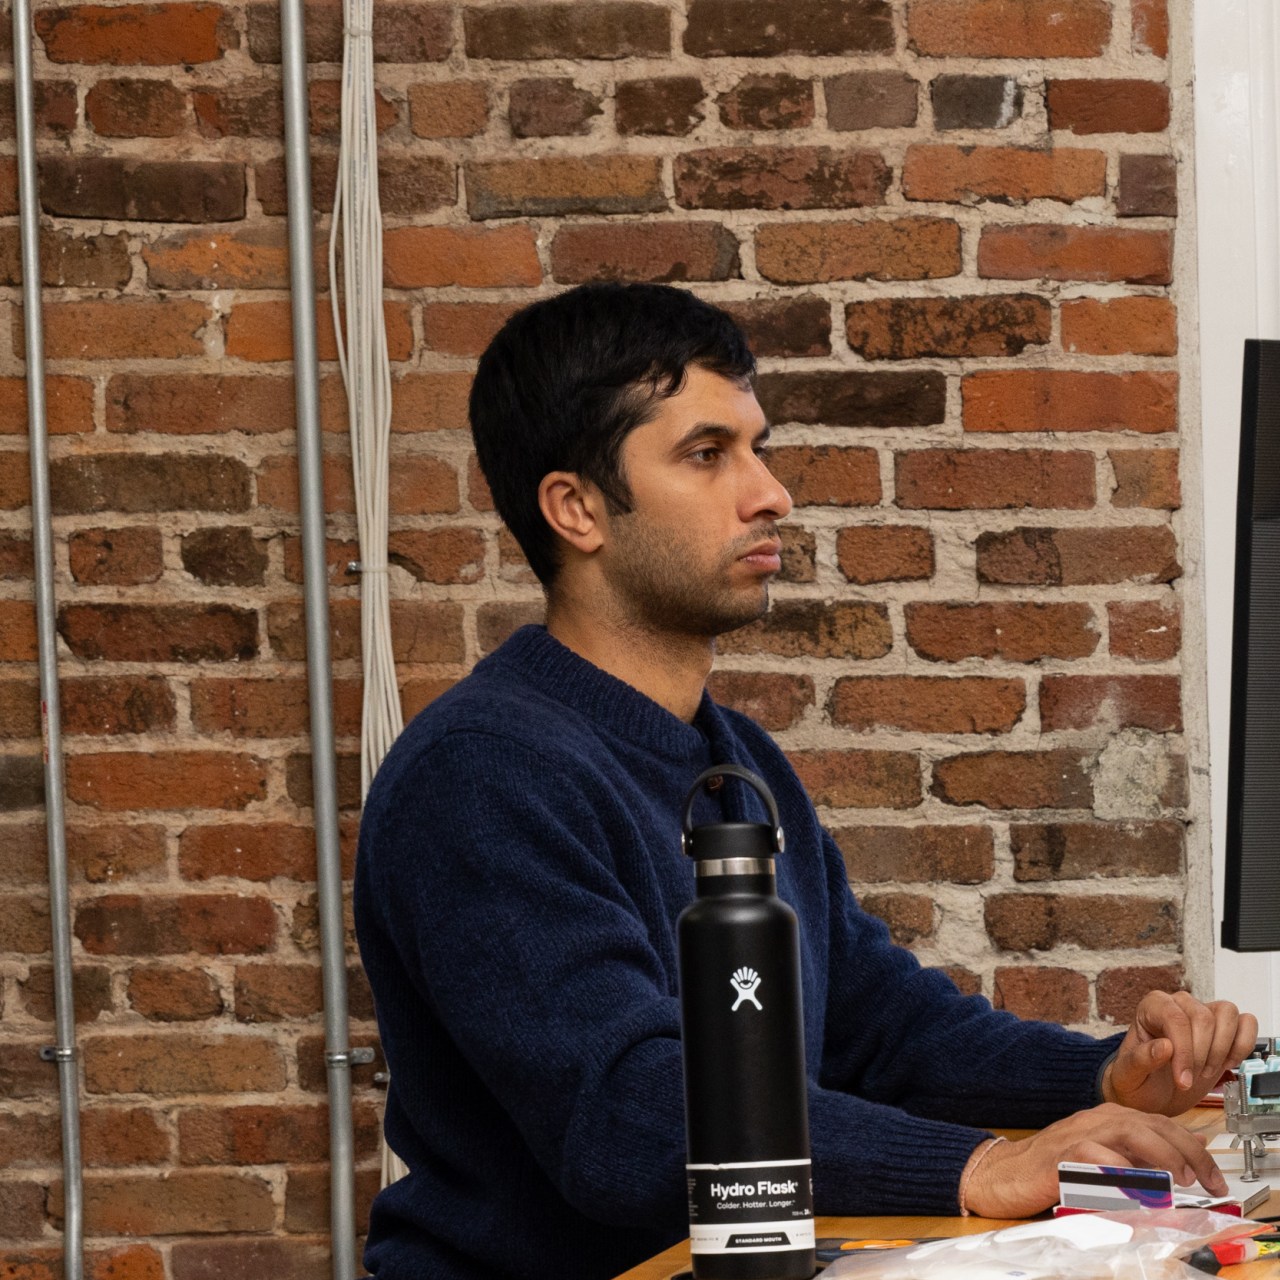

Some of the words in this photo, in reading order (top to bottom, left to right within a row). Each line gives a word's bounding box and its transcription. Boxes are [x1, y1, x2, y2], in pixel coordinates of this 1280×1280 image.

[711, 1183, 755, 1201] Hydro
[717, 1200, 742, 1210] Colder.
[742, 1200, 768, 1209] Hotter.
